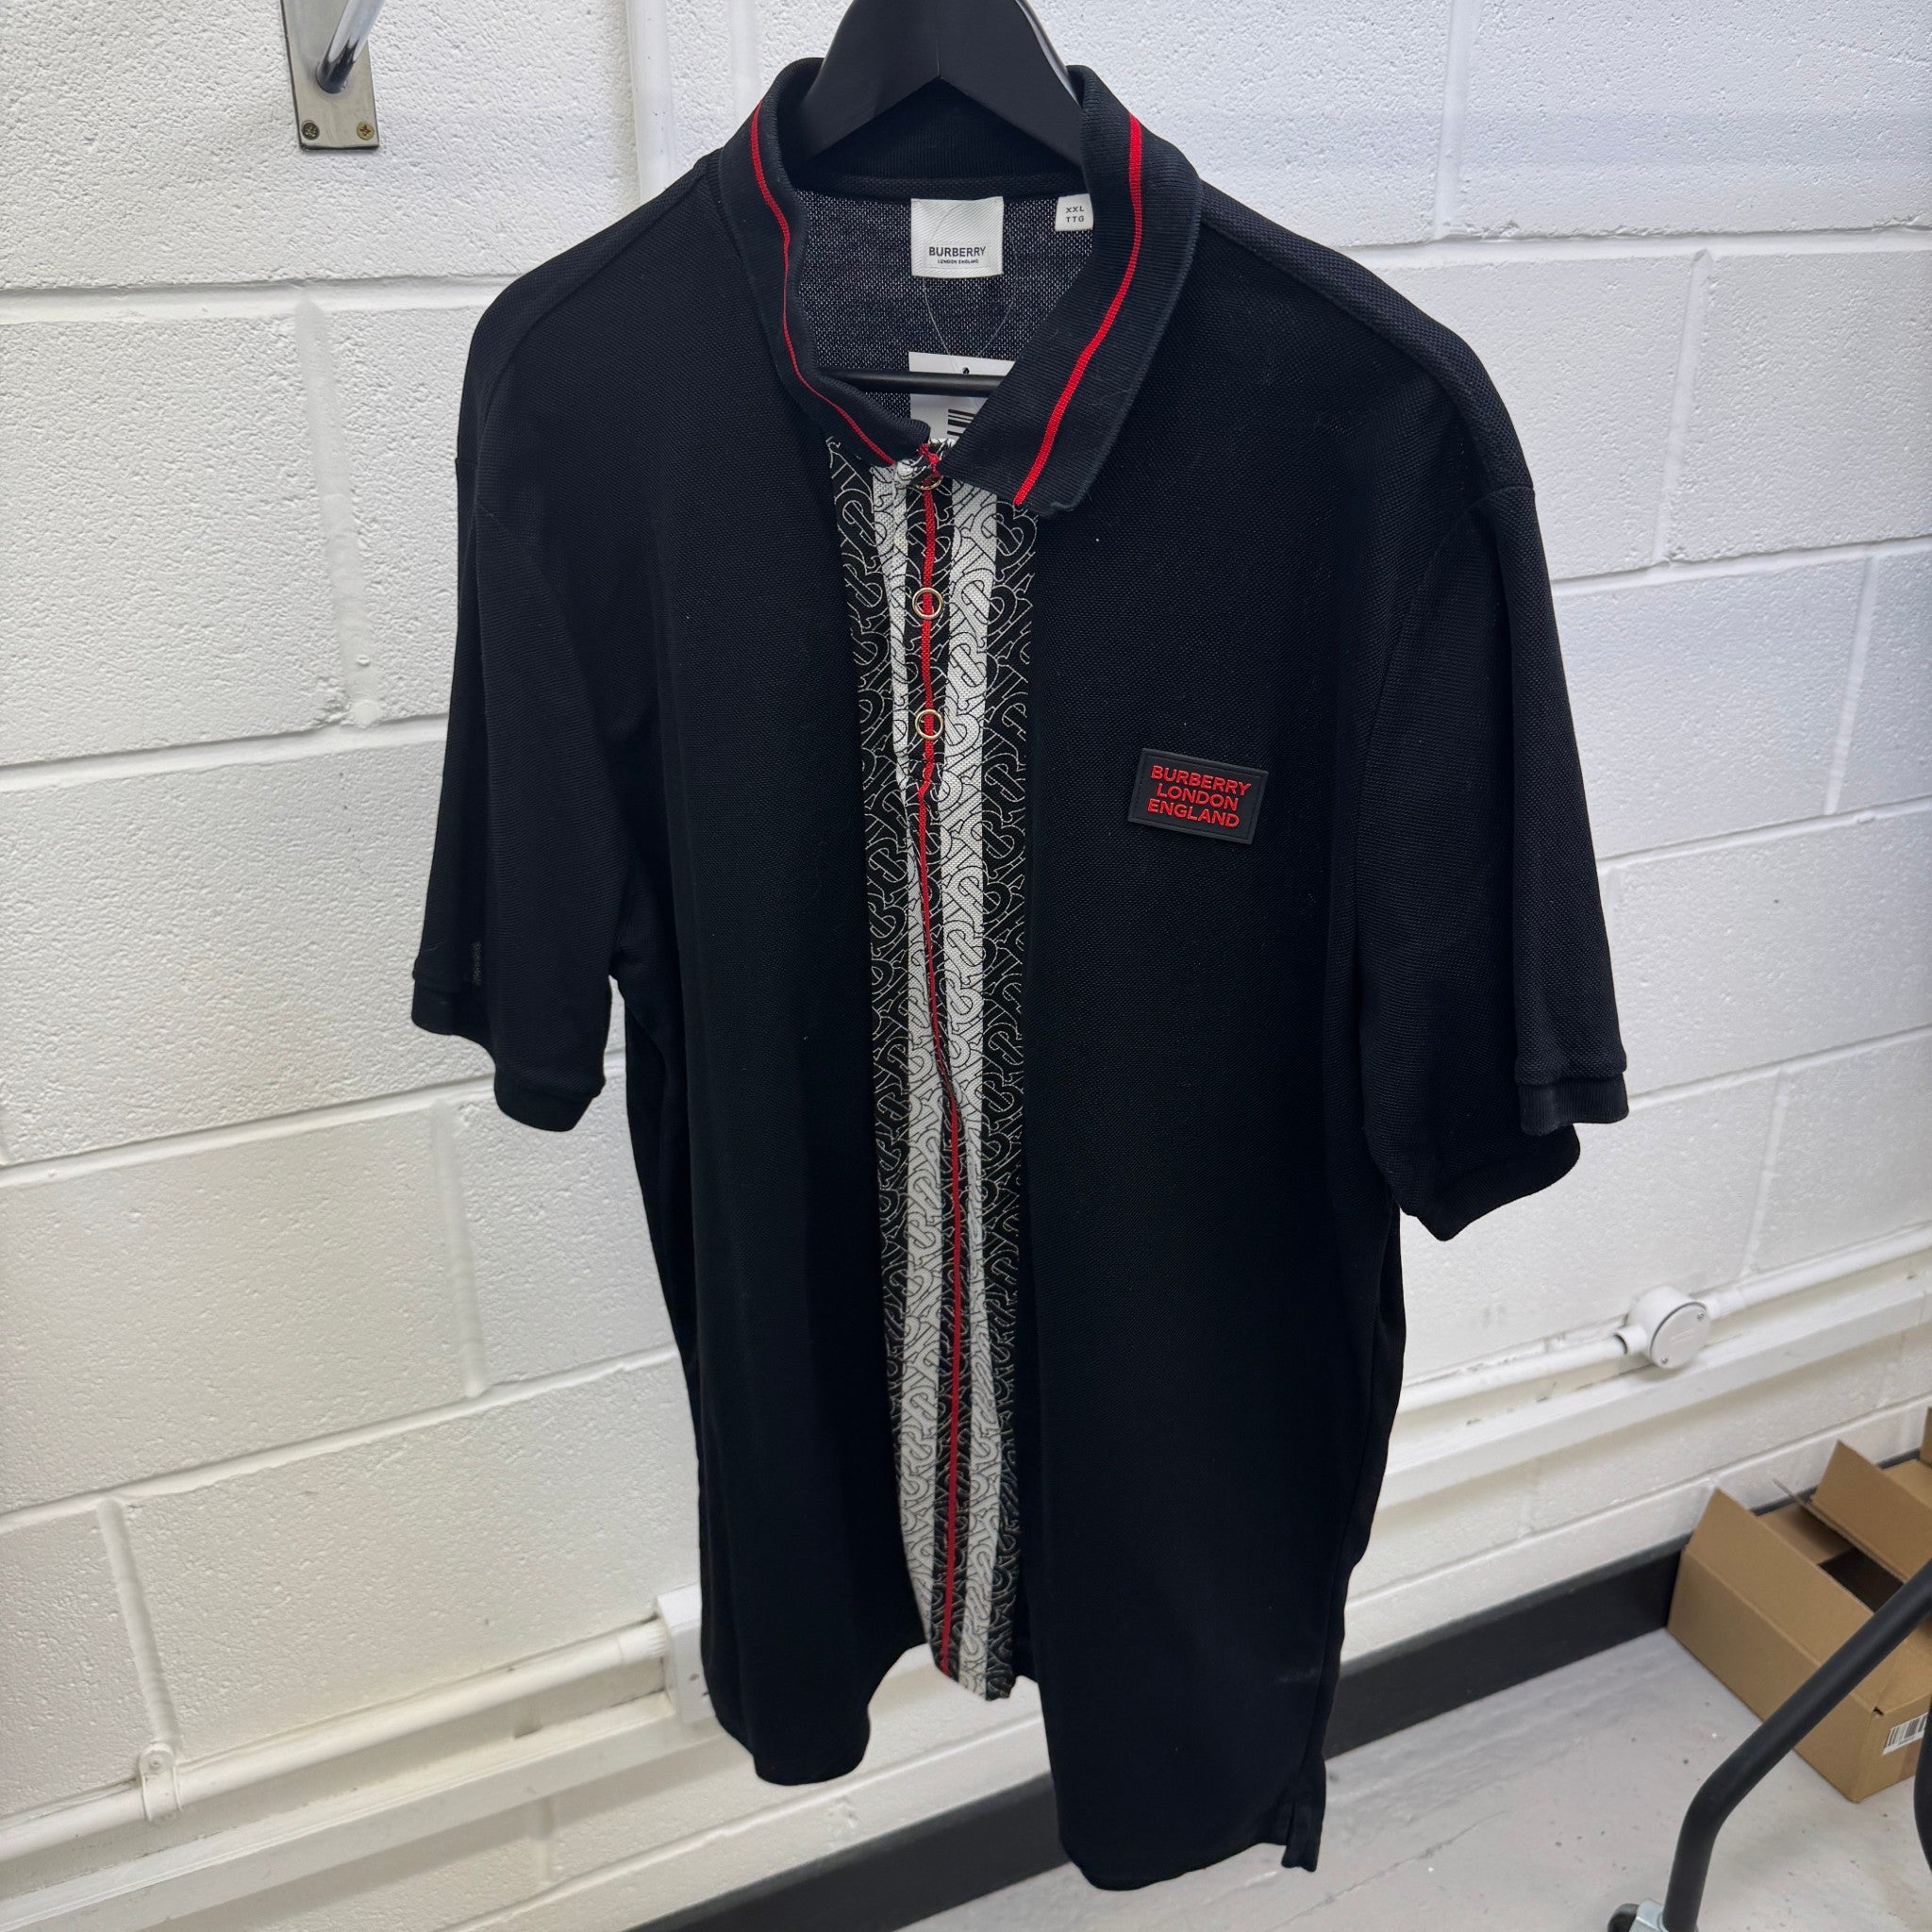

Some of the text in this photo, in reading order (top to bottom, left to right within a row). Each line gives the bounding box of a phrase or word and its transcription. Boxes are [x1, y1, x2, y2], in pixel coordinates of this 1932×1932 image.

[928, 245, 987, 258] BURBERRY
[1151, 765, 1251, 796] BURBERRY
[1157, 783, 1239, 811] LONDON
[1147, 798, 1241, 828] ENGLAND
